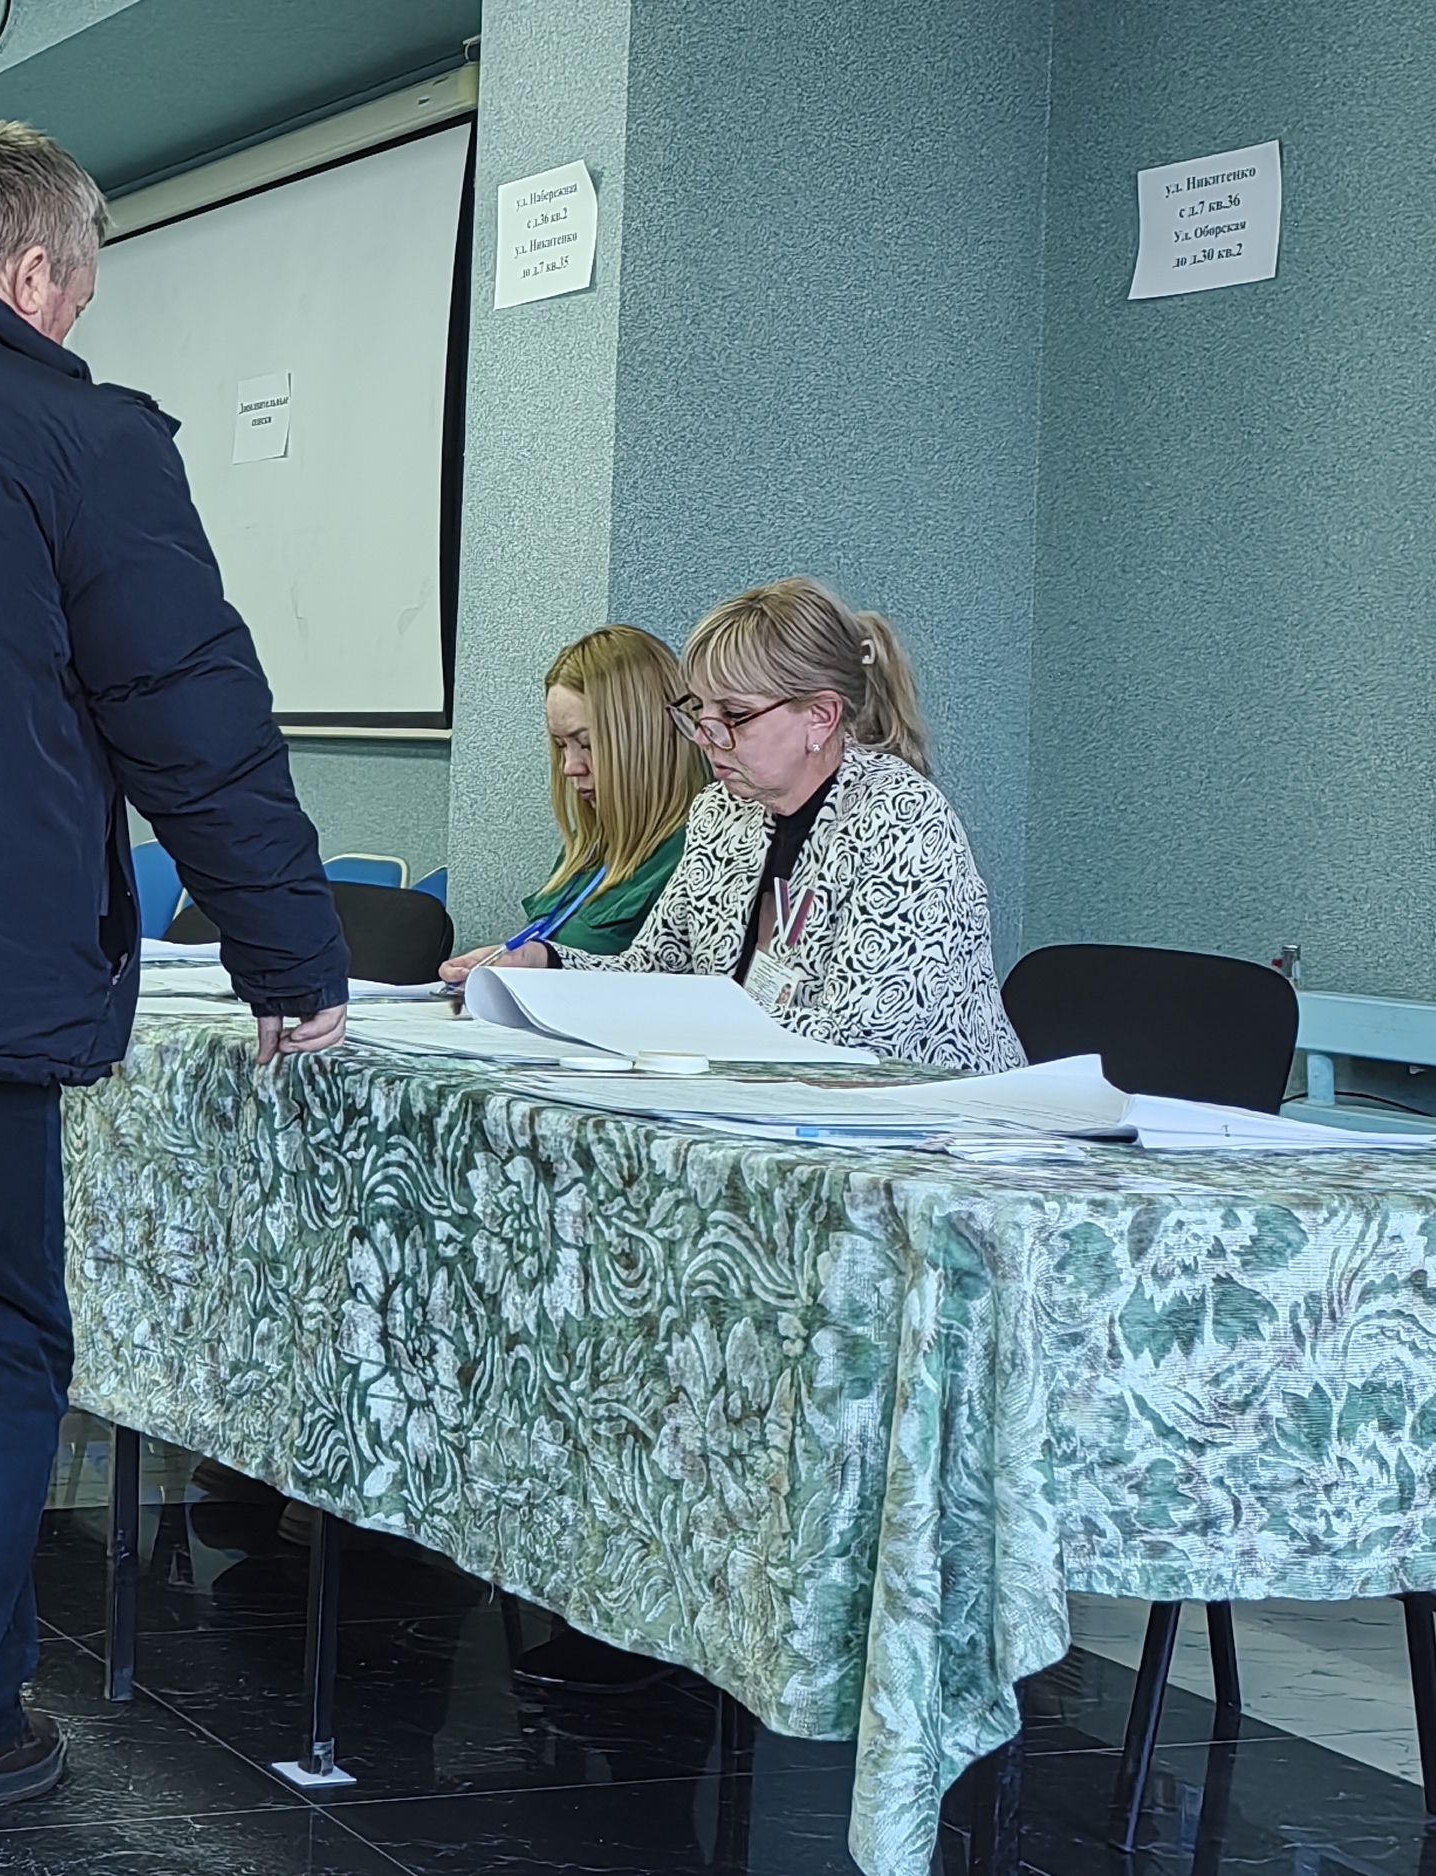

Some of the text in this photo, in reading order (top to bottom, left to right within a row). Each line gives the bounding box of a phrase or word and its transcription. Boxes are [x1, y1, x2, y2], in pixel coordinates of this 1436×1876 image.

[1164, 166, 1256, 198] ул. Никитенко
[516, 198, 528, 212] ул.
[1178, 193, 1241, 219] с д.7 кв.36
[1194, 220, 1247, 238] Оборская
[514, 246, 527, 259] ул.
[1171, 242, 1243, 268] до д.30 кв.2
